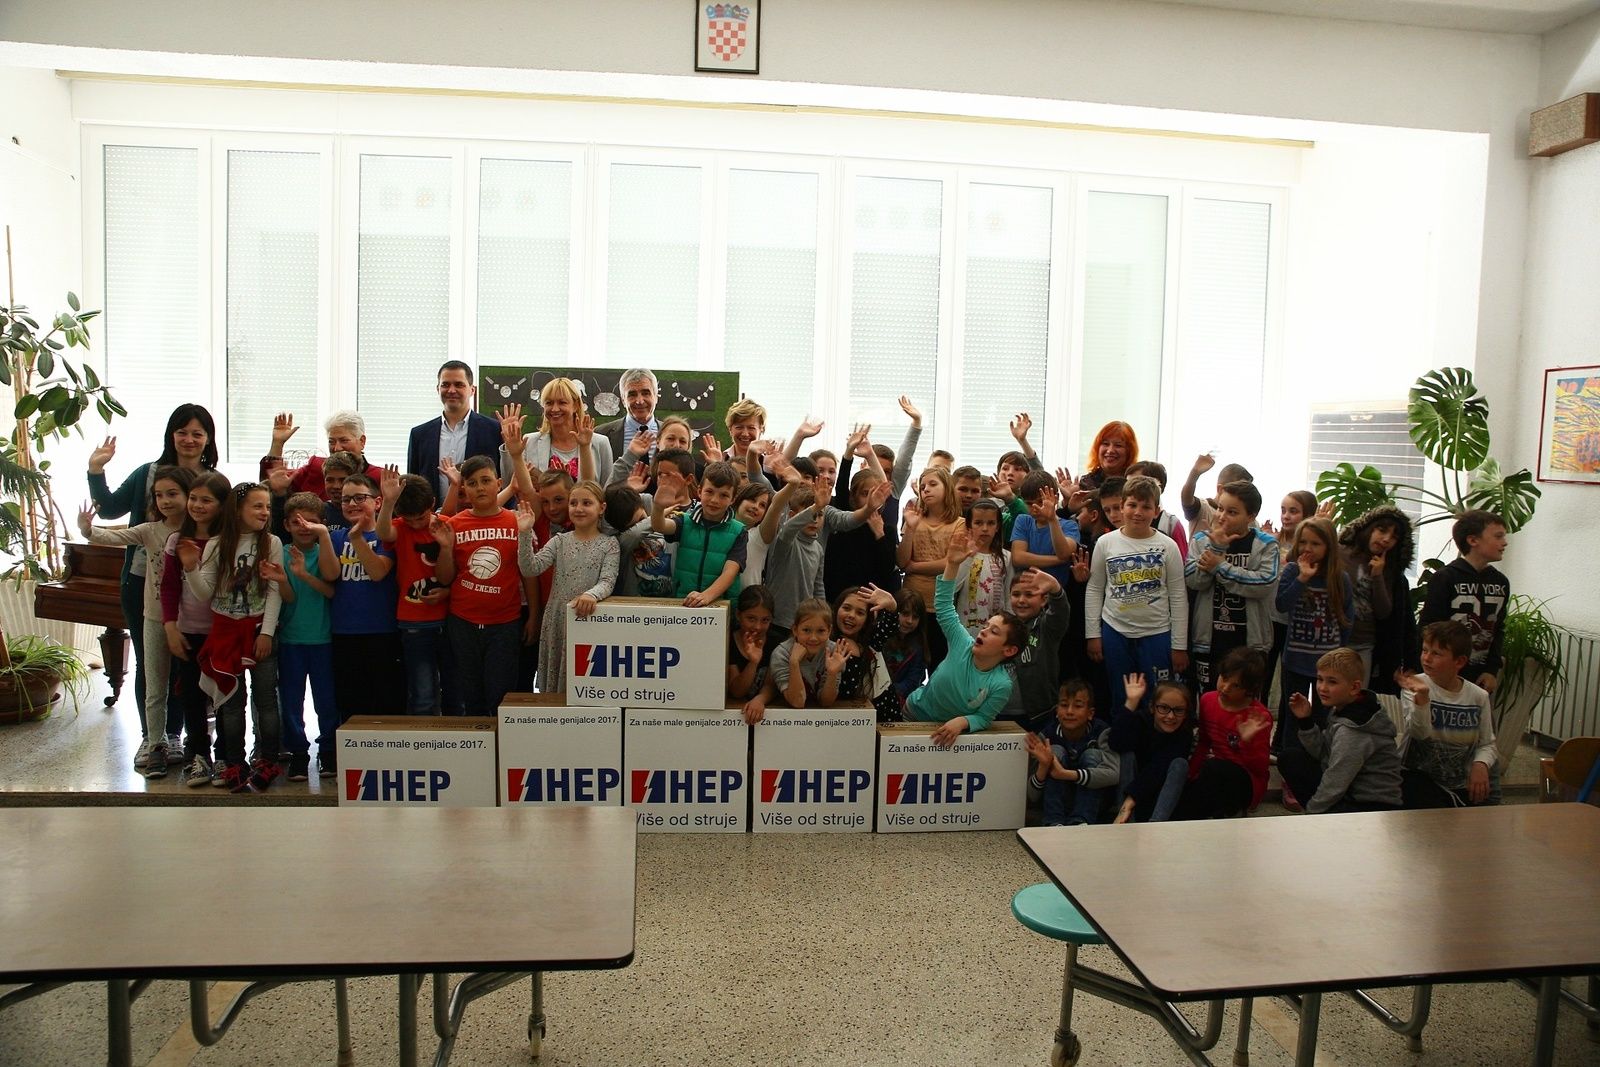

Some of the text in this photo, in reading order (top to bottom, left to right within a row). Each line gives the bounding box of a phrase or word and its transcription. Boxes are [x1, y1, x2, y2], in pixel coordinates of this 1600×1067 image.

[455, 528, 518, 545] HANDBALL
[1109, 567, 1162, 586] URBAN
[474, 583, 502, 594] ENERGY
[1454, 583, 1506, 596] NEW YORK
[590, 613, 615, 623] naše
[617, 614, 641, 624] male
[643, 615, 688, 628] genijalce
[690, 616, 718, 626] 2017.
[611, 645, 681, 679] HEP
[574, 685, 676, 702] Više od struje
[504, 715, 621, 727] Za naše male genijalce 2017.
[629, 717, 745, 730] Za naše male genijalce 2017.
[760, 718, 772, 726] Za
[772, 717, 792, 726] naše
[793, 718, 814, 727] male
[814, 718, 850, 729] genijalce
[851, 718, 874, 728] 2017.
[1440, 709, 1480, 727] VEGAS
[344, 737, 488, 751] Za naše male genijalce 2017.
[887, 742, 1022, 754] Za naše male genijalce 2017.
[381, 769, 451, 802] HEP
[546, 768, 620, 802] HEP
[669, 770, 743, 804] HEP
[798, 769, 871, 803] HEP
[920, 772, 987, 804] HEP
[669, 812, 689, 826] od
[694, 812, 738, 828] struje
[760, 811, 865, 828] Više od struje
[885, 811, 981, 827] Više od struje
